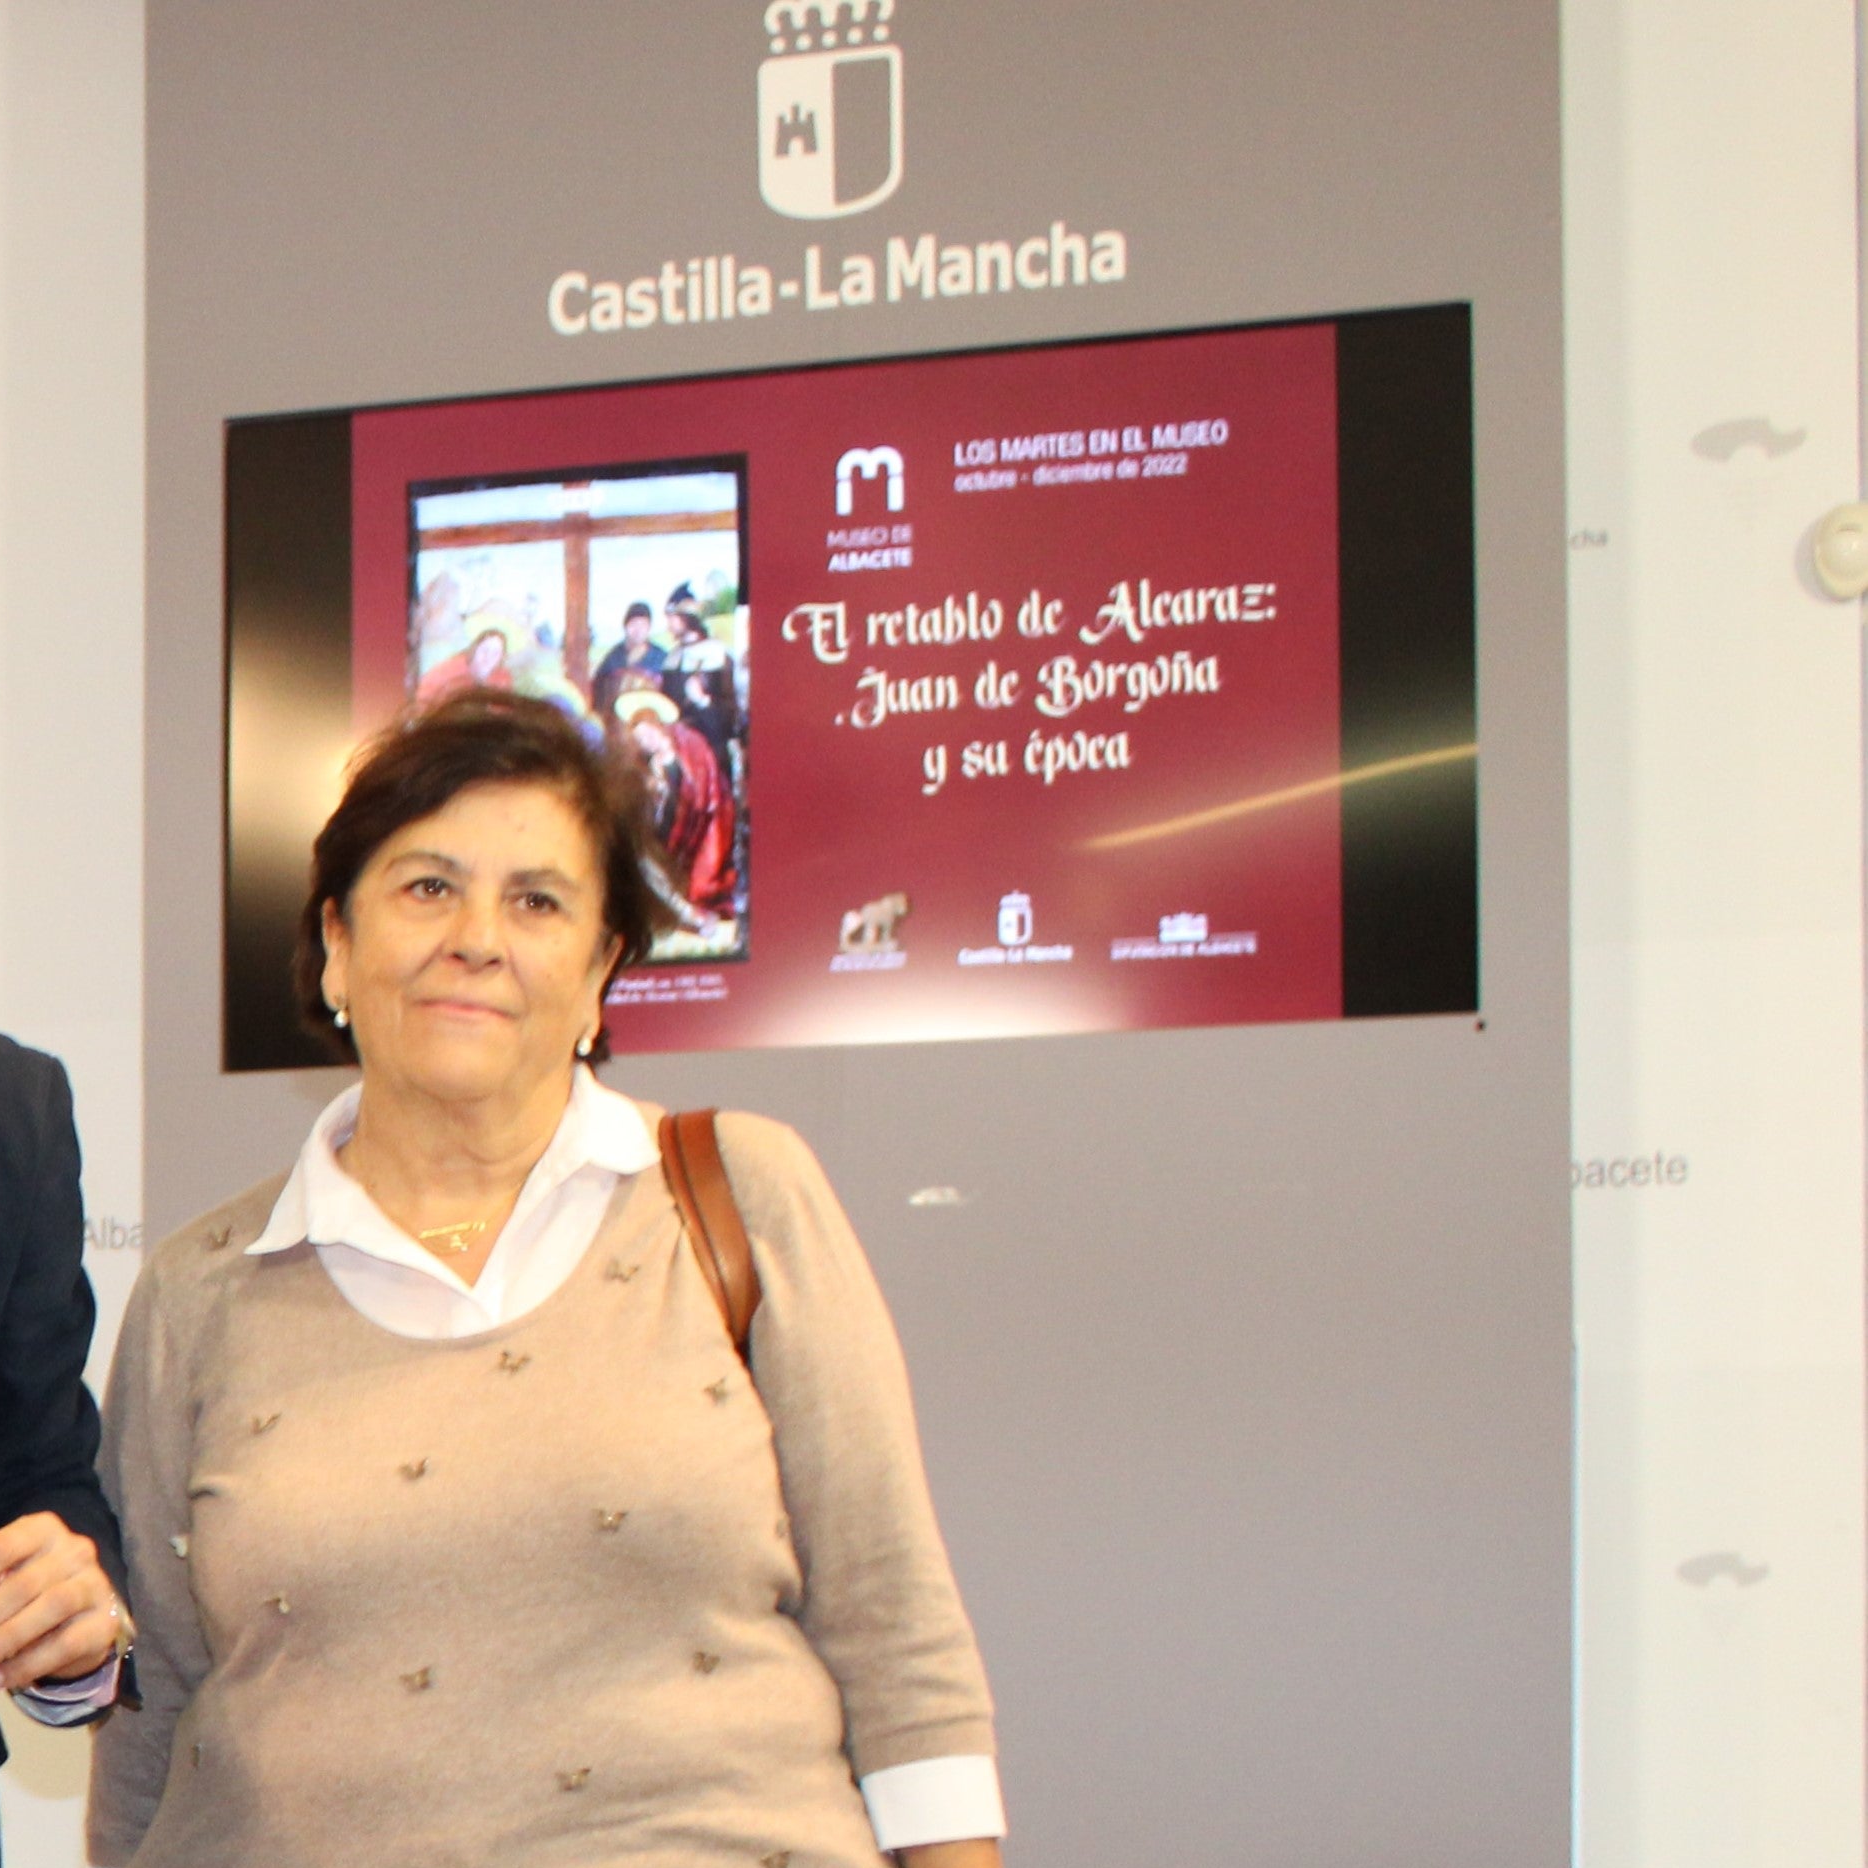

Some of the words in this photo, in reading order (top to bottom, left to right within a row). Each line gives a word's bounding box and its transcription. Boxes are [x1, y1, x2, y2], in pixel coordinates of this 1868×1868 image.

[885, 221, 1127, 302] Mancha
[954, 439, 995, 467] LOS
[1000, 431, 1085, 463] MARTES
[1089, 428, 1118, 455] EN
[1122, 426, 1147, 452] EL
[1152, 419, 1228, 449] MUSEO
[1142, 452, 1188, 478] 2022
[827, 546, 913, 572] ALBACETE
[781, 601, 849, 664] El
[867, 591, 1003, 647] retablo
[1017, 589, 1063, 638] de
[835, 666, 958, 728] Juan
[974, 661, 1020, 709] de
[1034, 651, 1220, 719] Borgoña
[921, 744, 948, 796] y
[962, 738, 1009, 778] su
[1024, 729, 1132, 785] época
